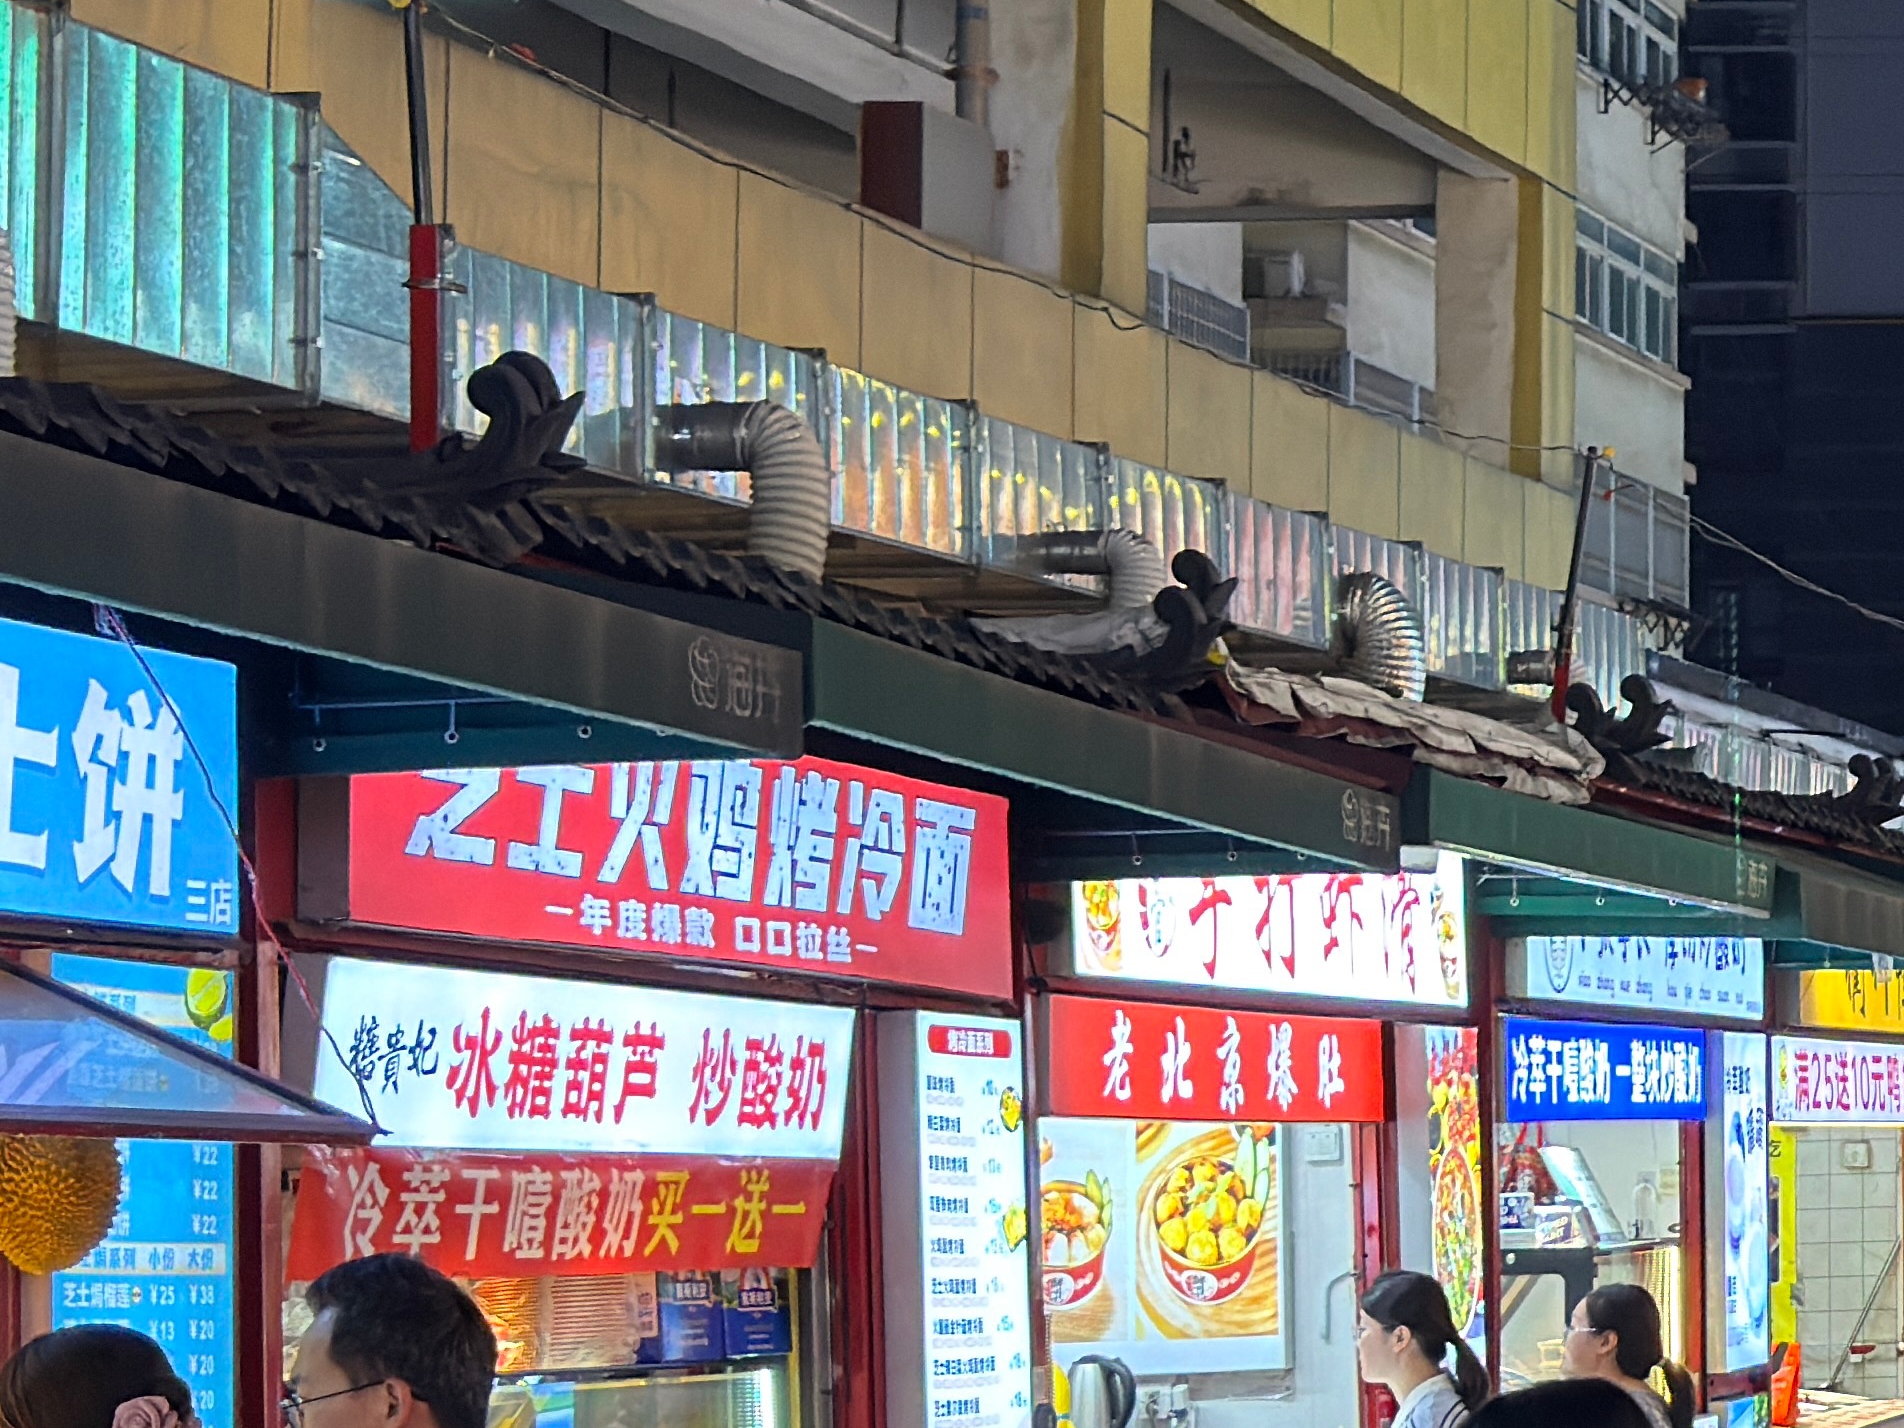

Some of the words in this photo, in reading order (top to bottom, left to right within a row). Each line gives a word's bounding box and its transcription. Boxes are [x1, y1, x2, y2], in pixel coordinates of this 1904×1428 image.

[185, 879, 233, 927] 三店
[448, 1006, 666, 1126] 冰糖葫芦
[688, 1027, 828, 1132] 炒酸奶
[1102, 1008, 1346, 1116] 老北京爆肚
